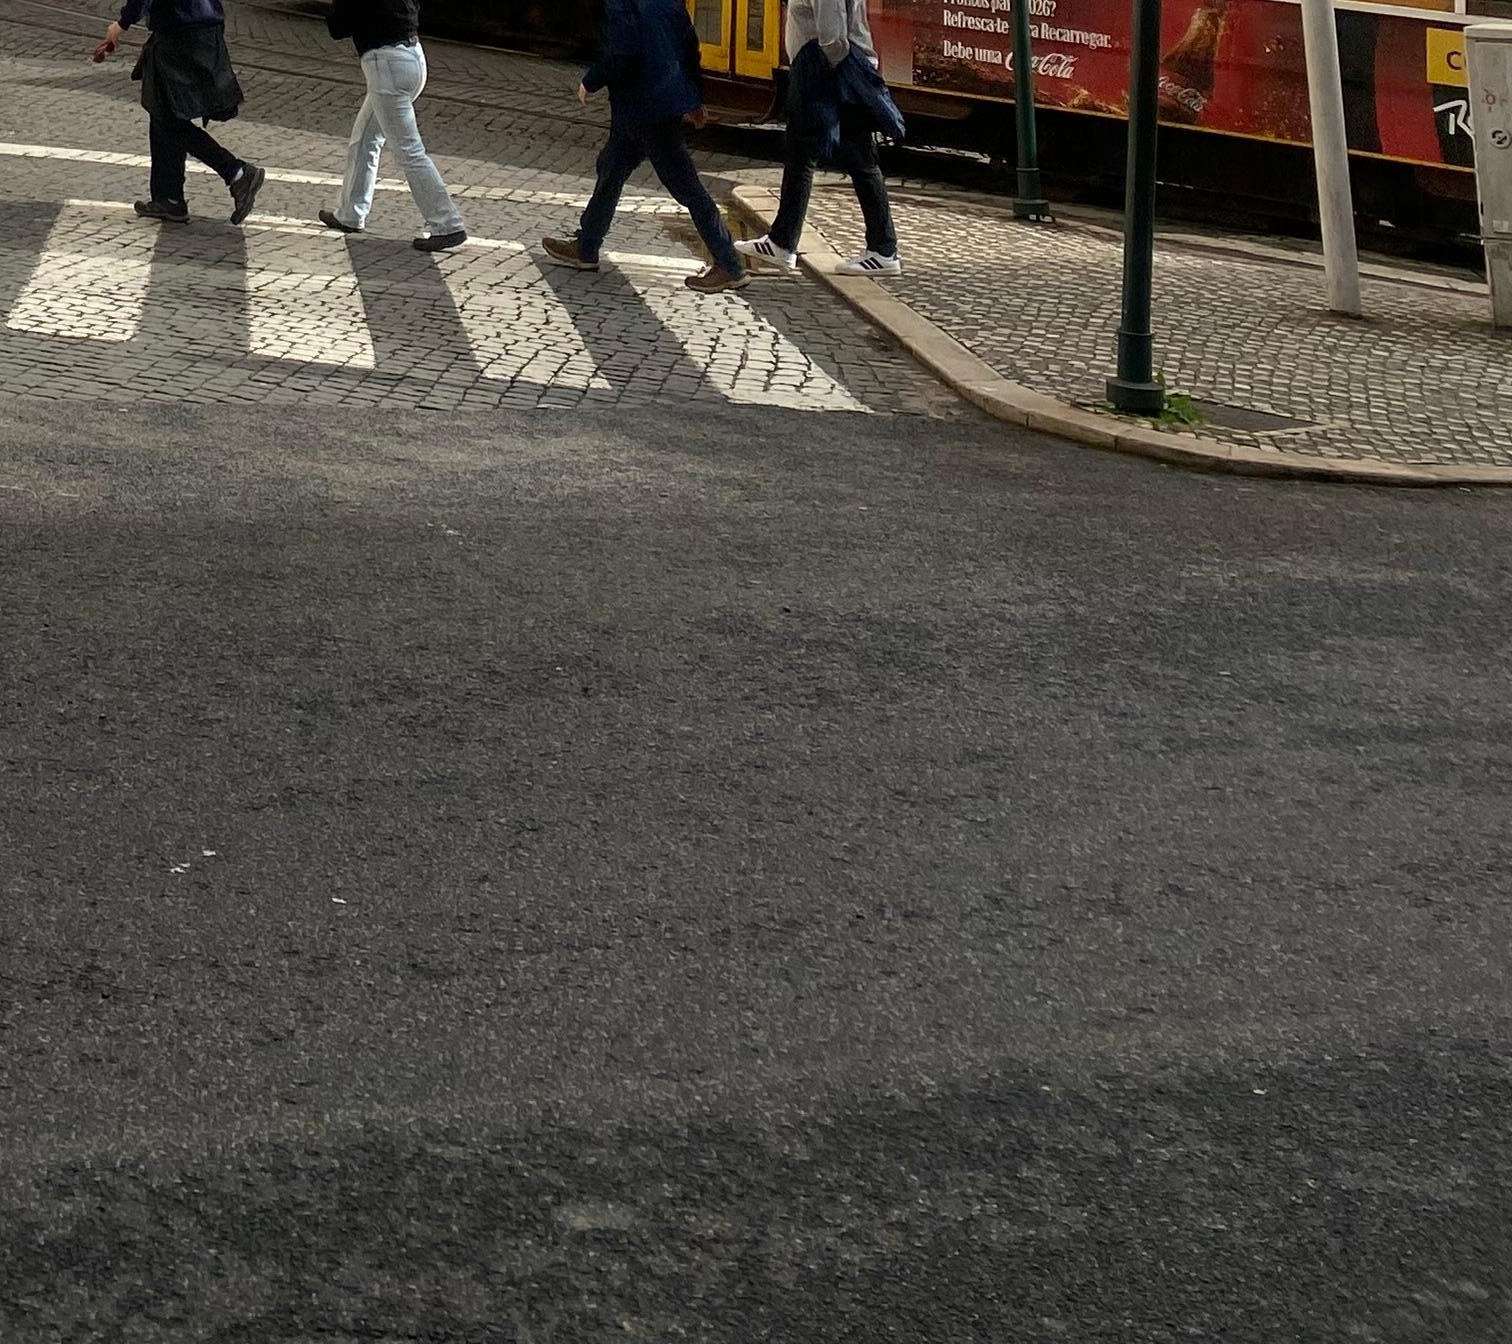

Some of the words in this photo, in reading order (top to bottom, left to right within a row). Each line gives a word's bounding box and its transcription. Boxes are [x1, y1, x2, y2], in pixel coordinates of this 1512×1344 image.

[943, 9, 1010, 34] Refresca-te
[1040, 22, 1113, 49] Recarregar.
[943, 40, 974, 60] Bebe
[974, 47, 1002, 64] uma
